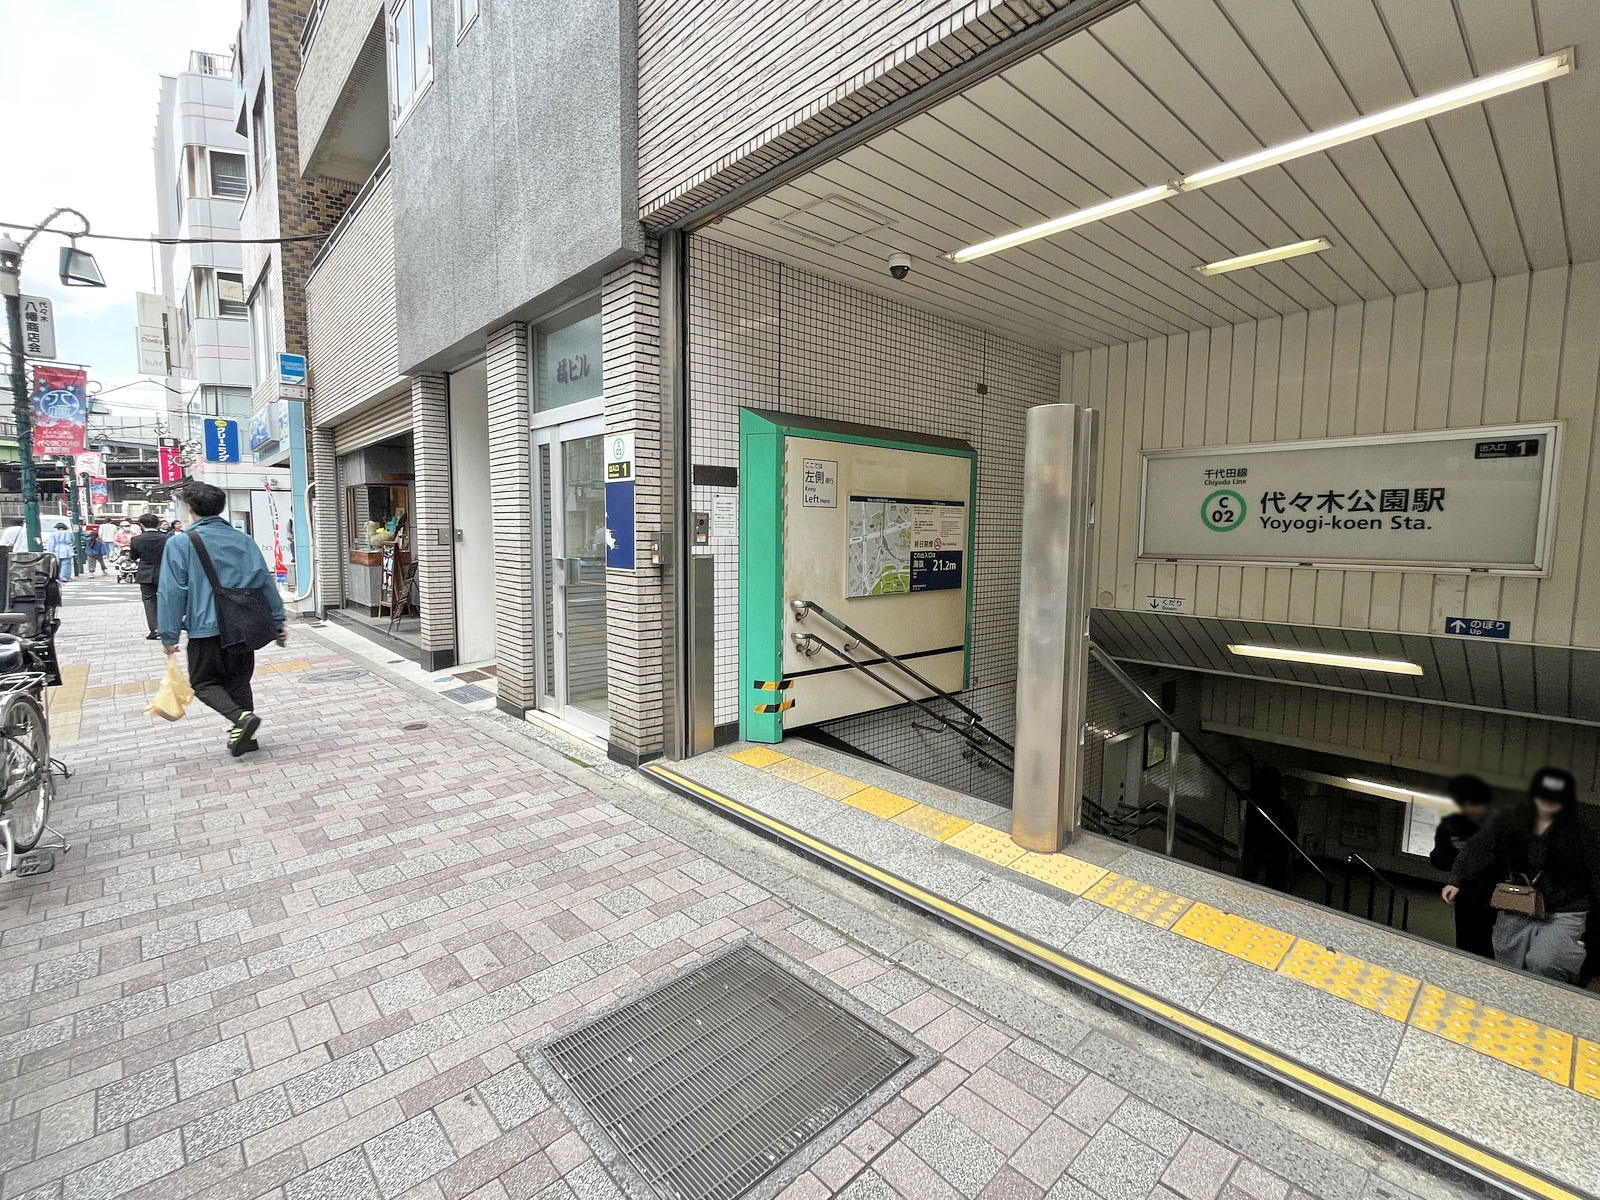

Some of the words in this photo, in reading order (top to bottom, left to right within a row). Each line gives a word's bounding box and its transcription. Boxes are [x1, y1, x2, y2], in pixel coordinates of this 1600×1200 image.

[39, 302, 49, 323] 代々木
[25, 301, 42, 353] 八幡商店会
[216, 427, 230, 461] クリーニング
[1479, 443, 1507, 452] 出入口
[1516, 441, 1526, 456] 1
[622, 463, 628, 477] 1
[1204, 468, 1248, 479] 千代田線
[1204, 479, 1231, 487] Chiyoda
[805, 494, 820, 504] Left
[1218, 496, 1229, 509] C
[1260, 487, 1446, 515] 代々木公園駅
[1212, 510, 1234, 523] 02
[1260, 515, 1382, 533] Yoyogi-koen
[1390, 515, 1433, 531] Sta.
[932, 559, 957, 571] 21.2m
[1470, 620, 1505, 631] のぼり
